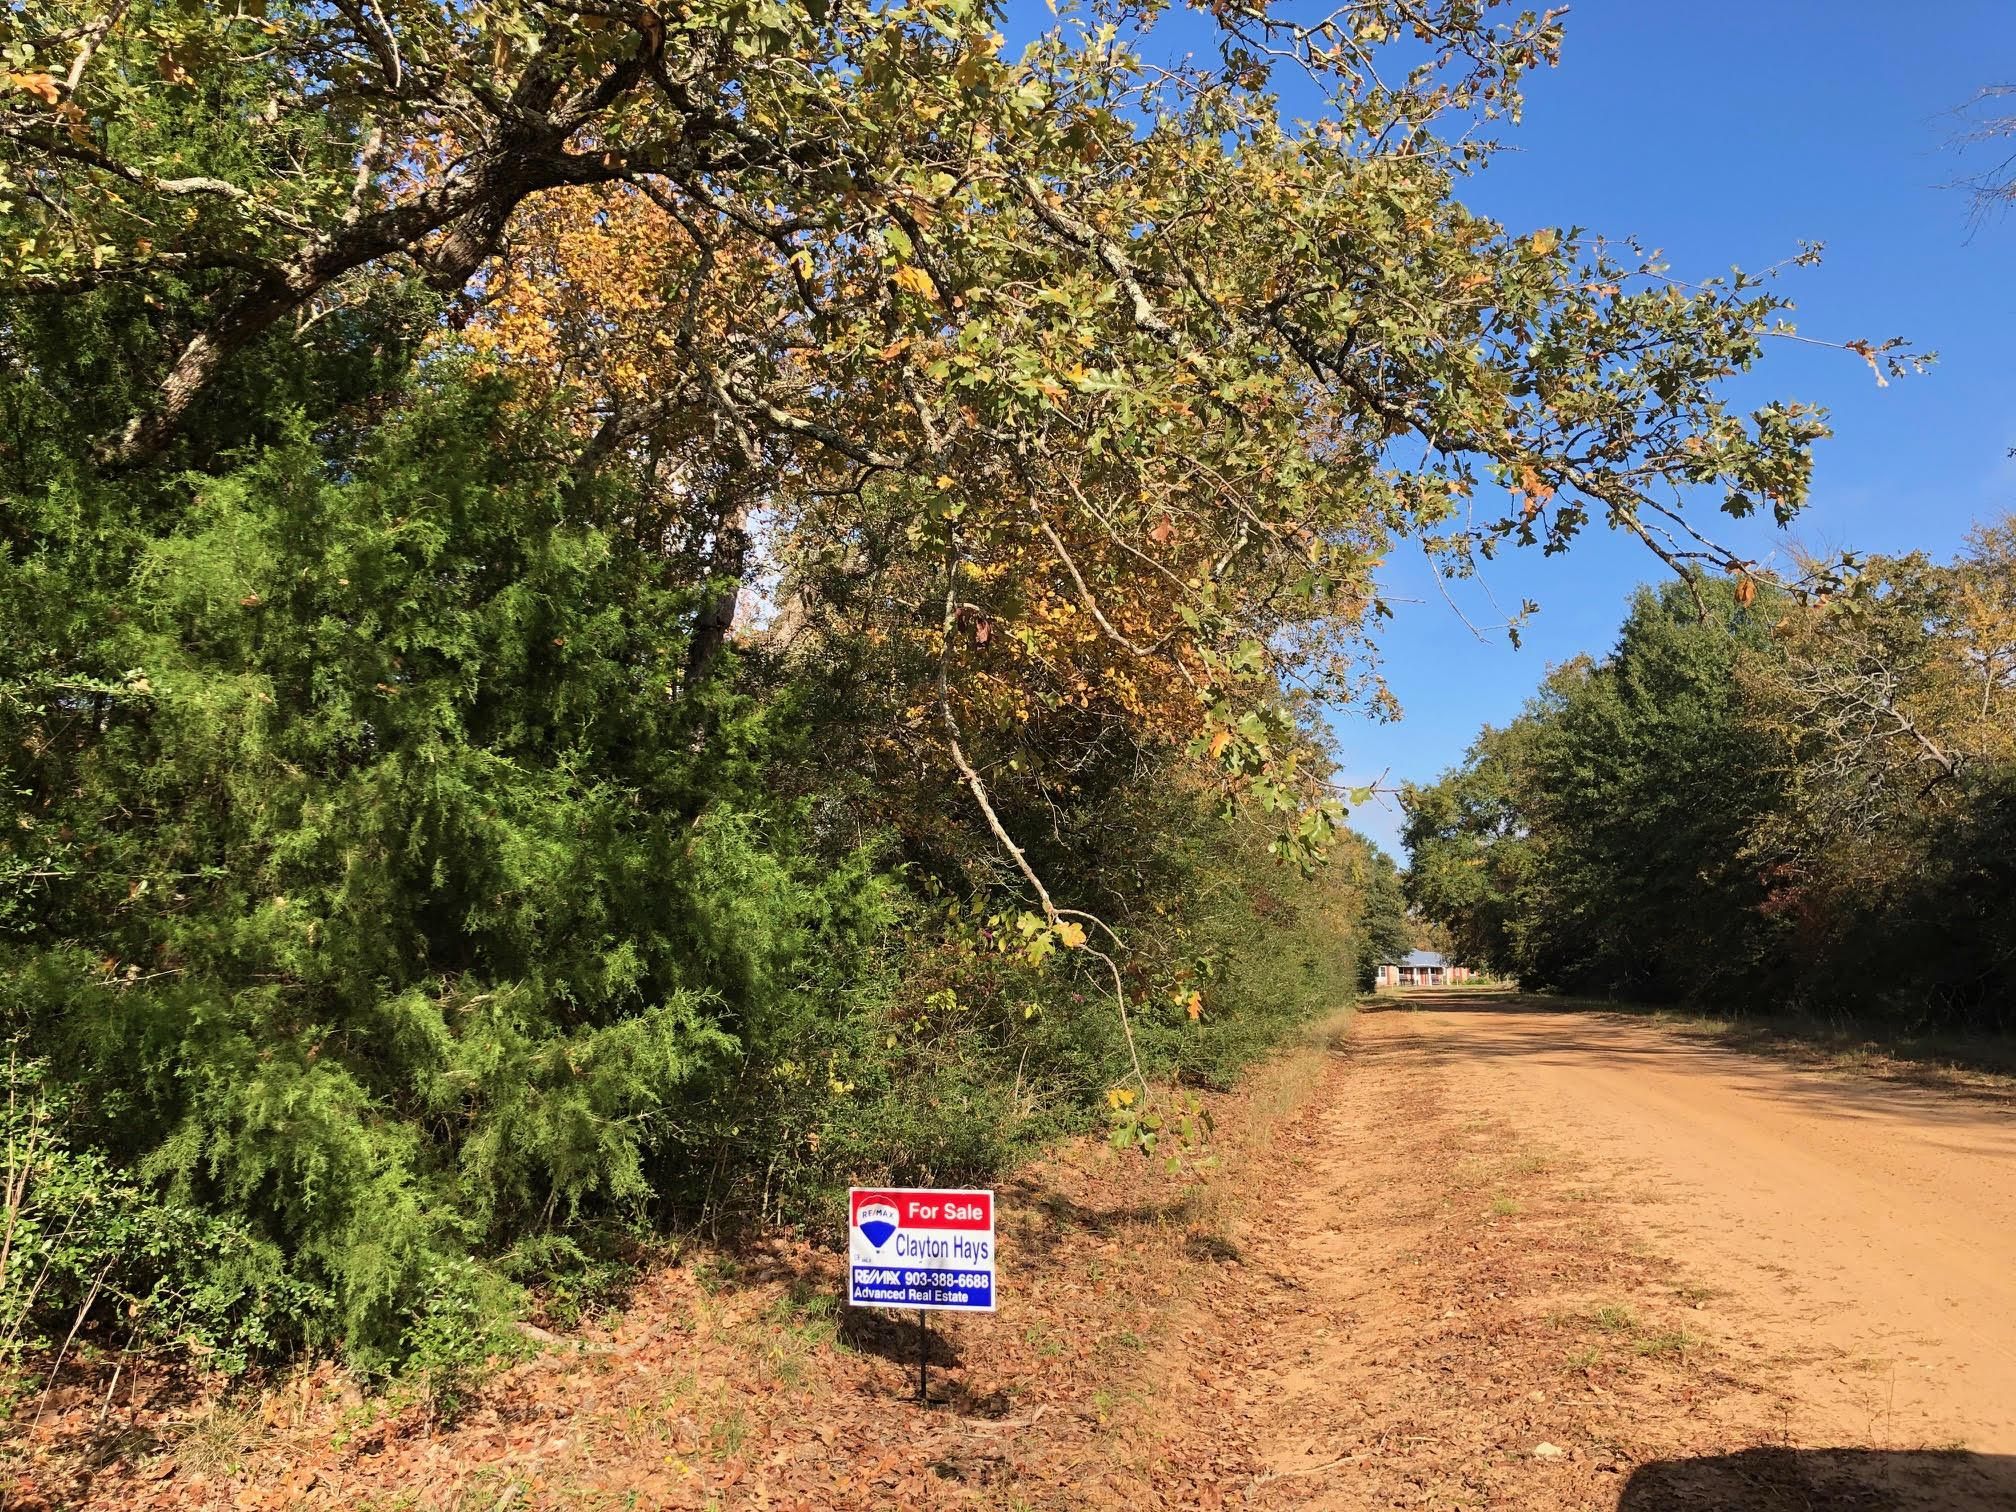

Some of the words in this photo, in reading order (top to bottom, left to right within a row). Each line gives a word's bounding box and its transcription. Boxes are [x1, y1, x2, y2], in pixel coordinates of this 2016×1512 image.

[862, 1209, 894, 1218] RE/MAX
[908, 1202, 938, 1219] For
[944, 1203, 983, 1220] Sale
[896, 1234, 948, 1259] Clayton
[954, 1235, 988, 1265] Hays
[854, 1269, 901, 1285] RE/MAX
[905, 1271, 989, 1288] 903-388-6688
[854, 1286, 905, 1300] Advanced
[908, 1289, 931, 1301] Real
[935, 1290, 968, 1302] Estate
